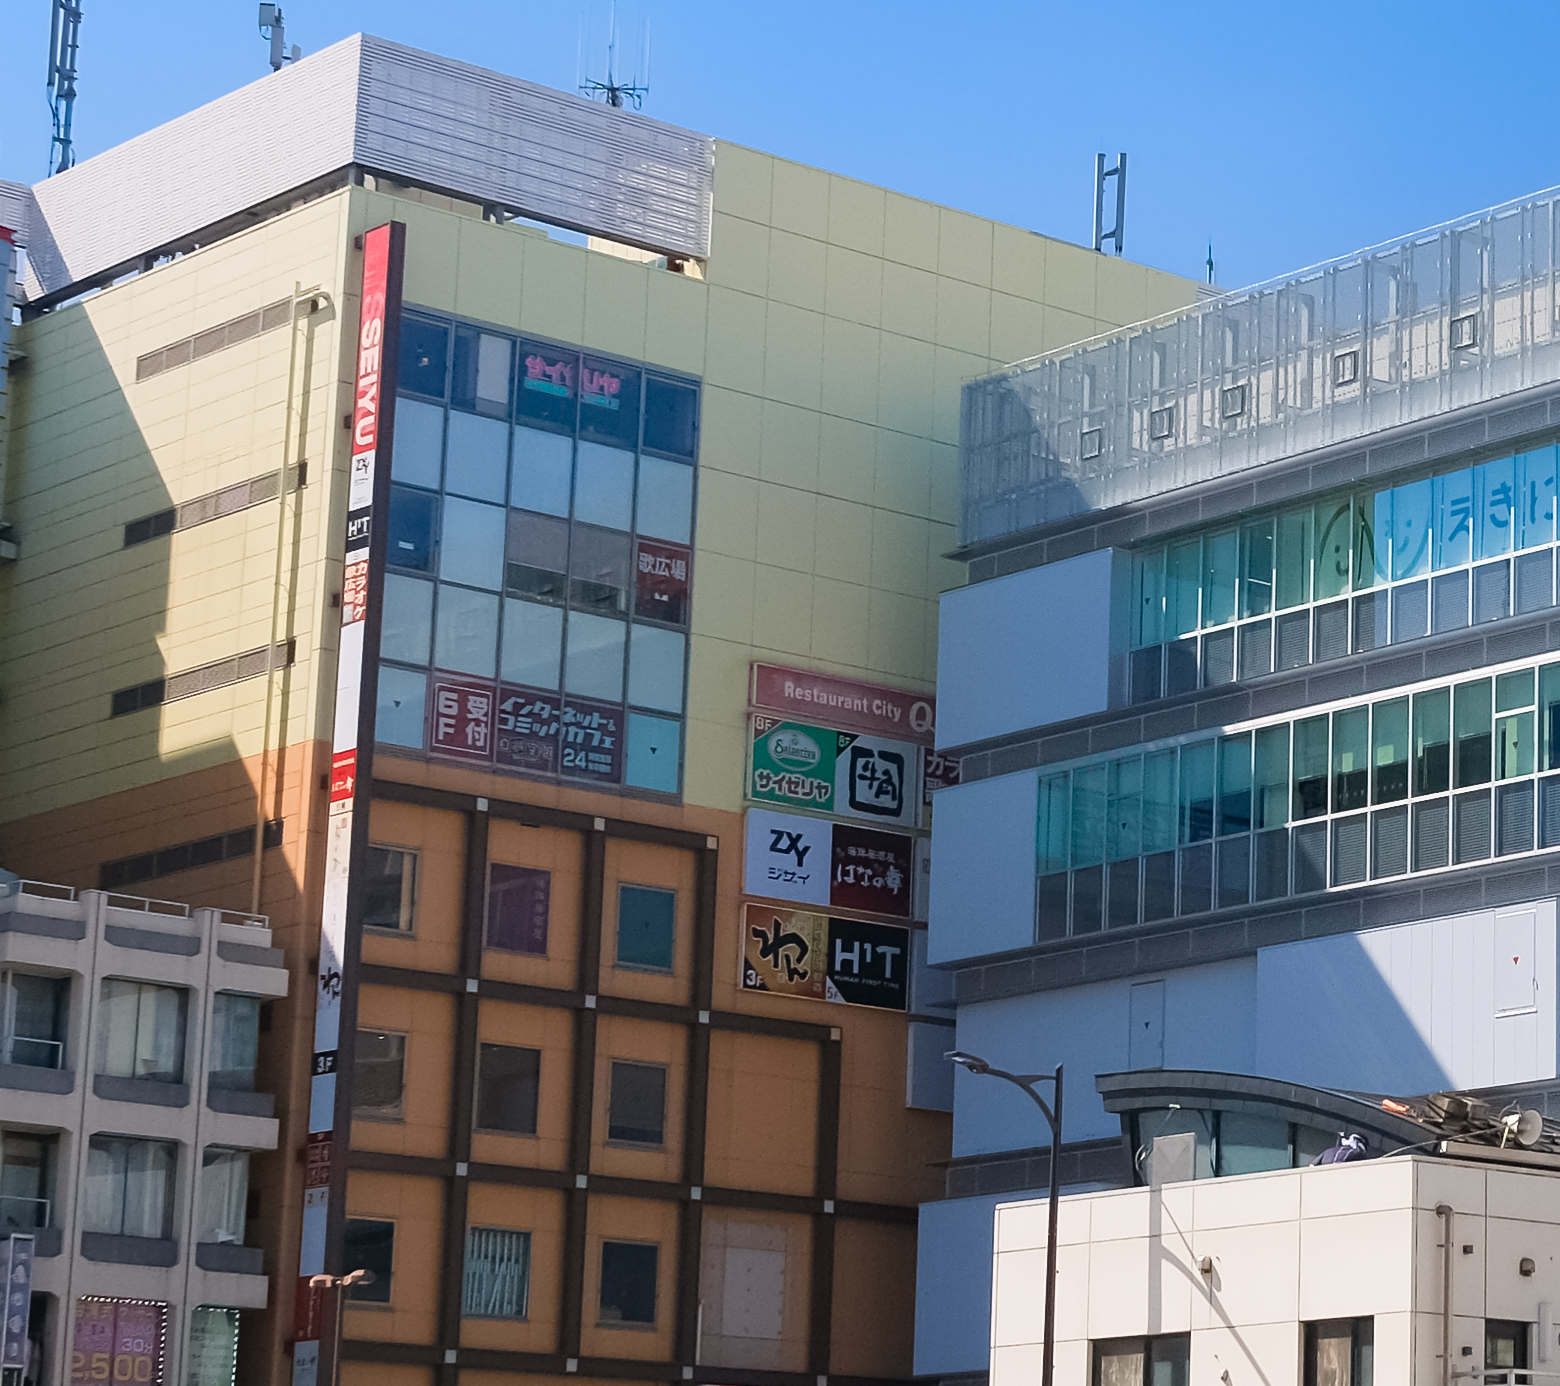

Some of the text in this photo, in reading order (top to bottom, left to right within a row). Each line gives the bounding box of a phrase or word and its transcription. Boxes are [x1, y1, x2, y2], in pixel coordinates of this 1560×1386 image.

[354, 316, 382, 447] SEIYU
[437, 690, 459, 740] 6F
[465, 695, 489, 747] 受付
[784, 681, 869, 714] Restaurant
[872, 699, 903, 723] City
[755, 717, 773, 731] 8F
[562, 747, 587, 769] 24
[754, 768, 832, 803] サイゼリヤ
[769, 828, 812, 868] ZXY
